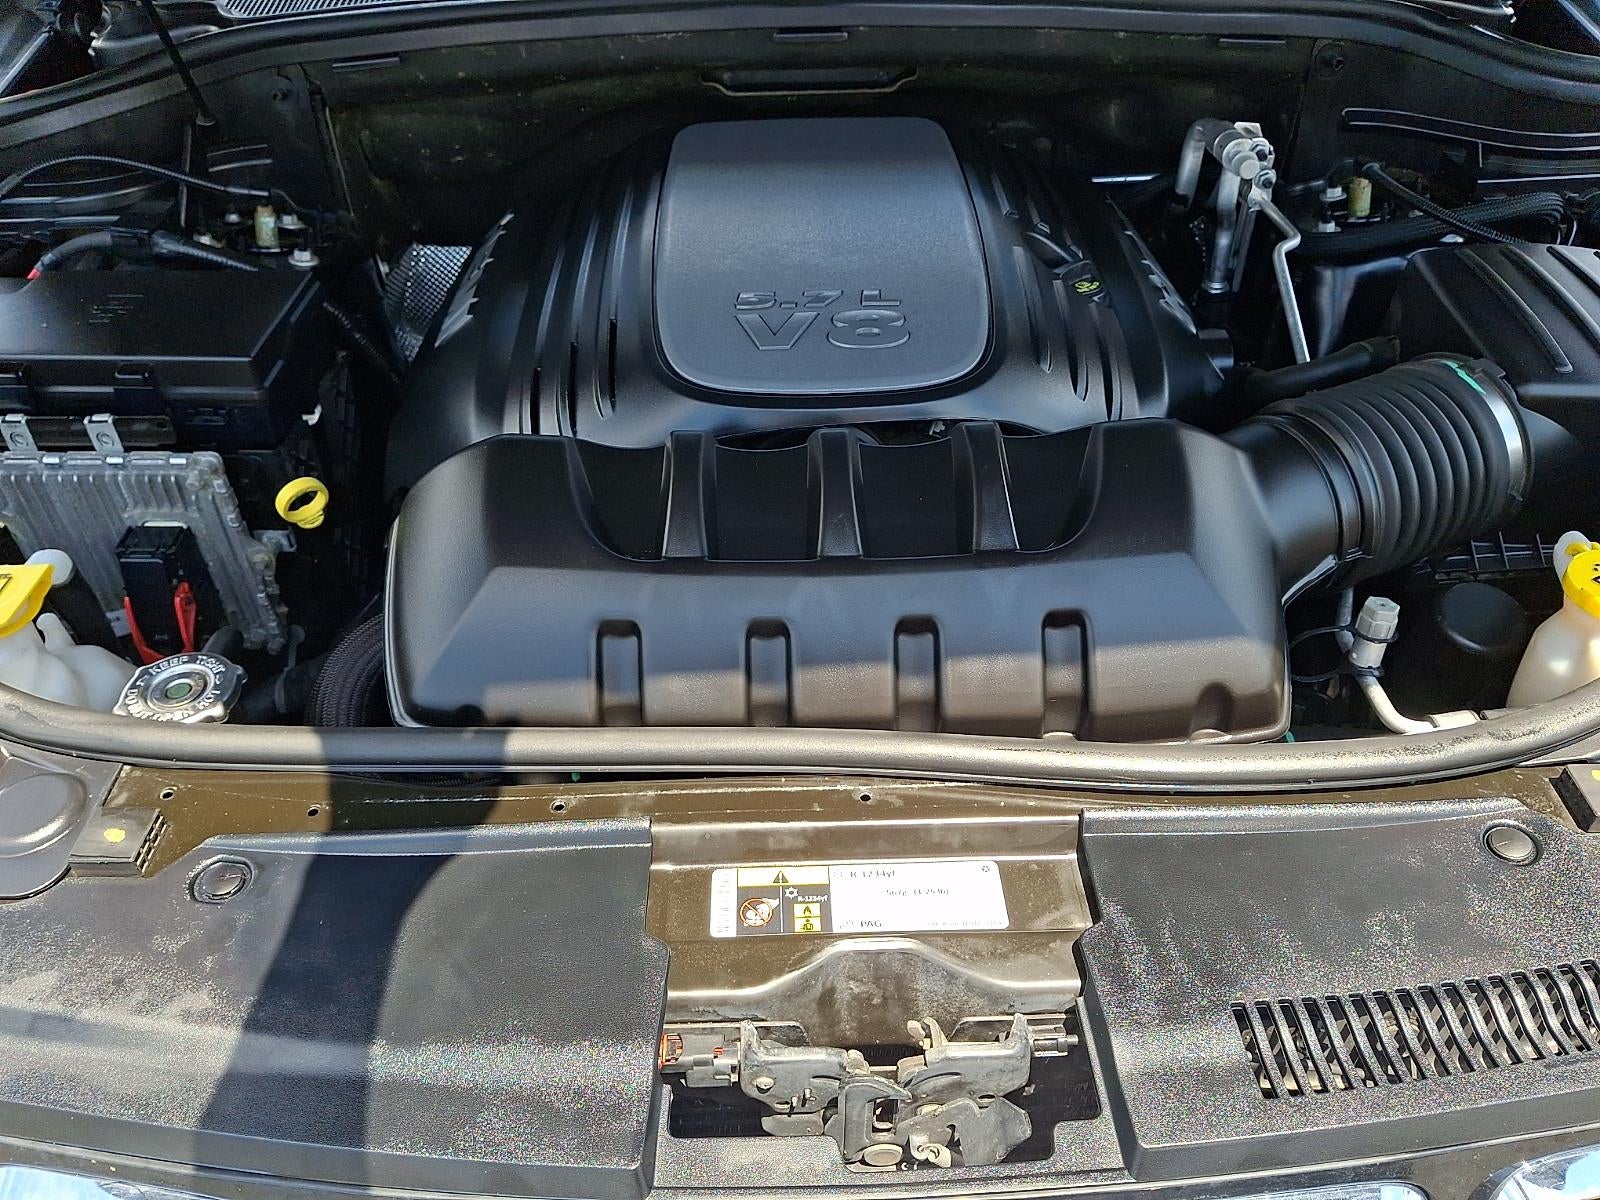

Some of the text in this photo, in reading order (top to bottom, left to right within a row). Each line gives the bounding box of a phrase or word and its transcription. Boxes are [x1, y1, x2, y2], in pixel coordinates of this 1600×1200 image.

[735, 288, 902, 310] 5.7 L
[734, 309, 911, 350] V8
[148, 654, 226, 676] KEEP TIGHT
[125, 688, 139, 705] DO
[860, 920, 882, 928] PAG
